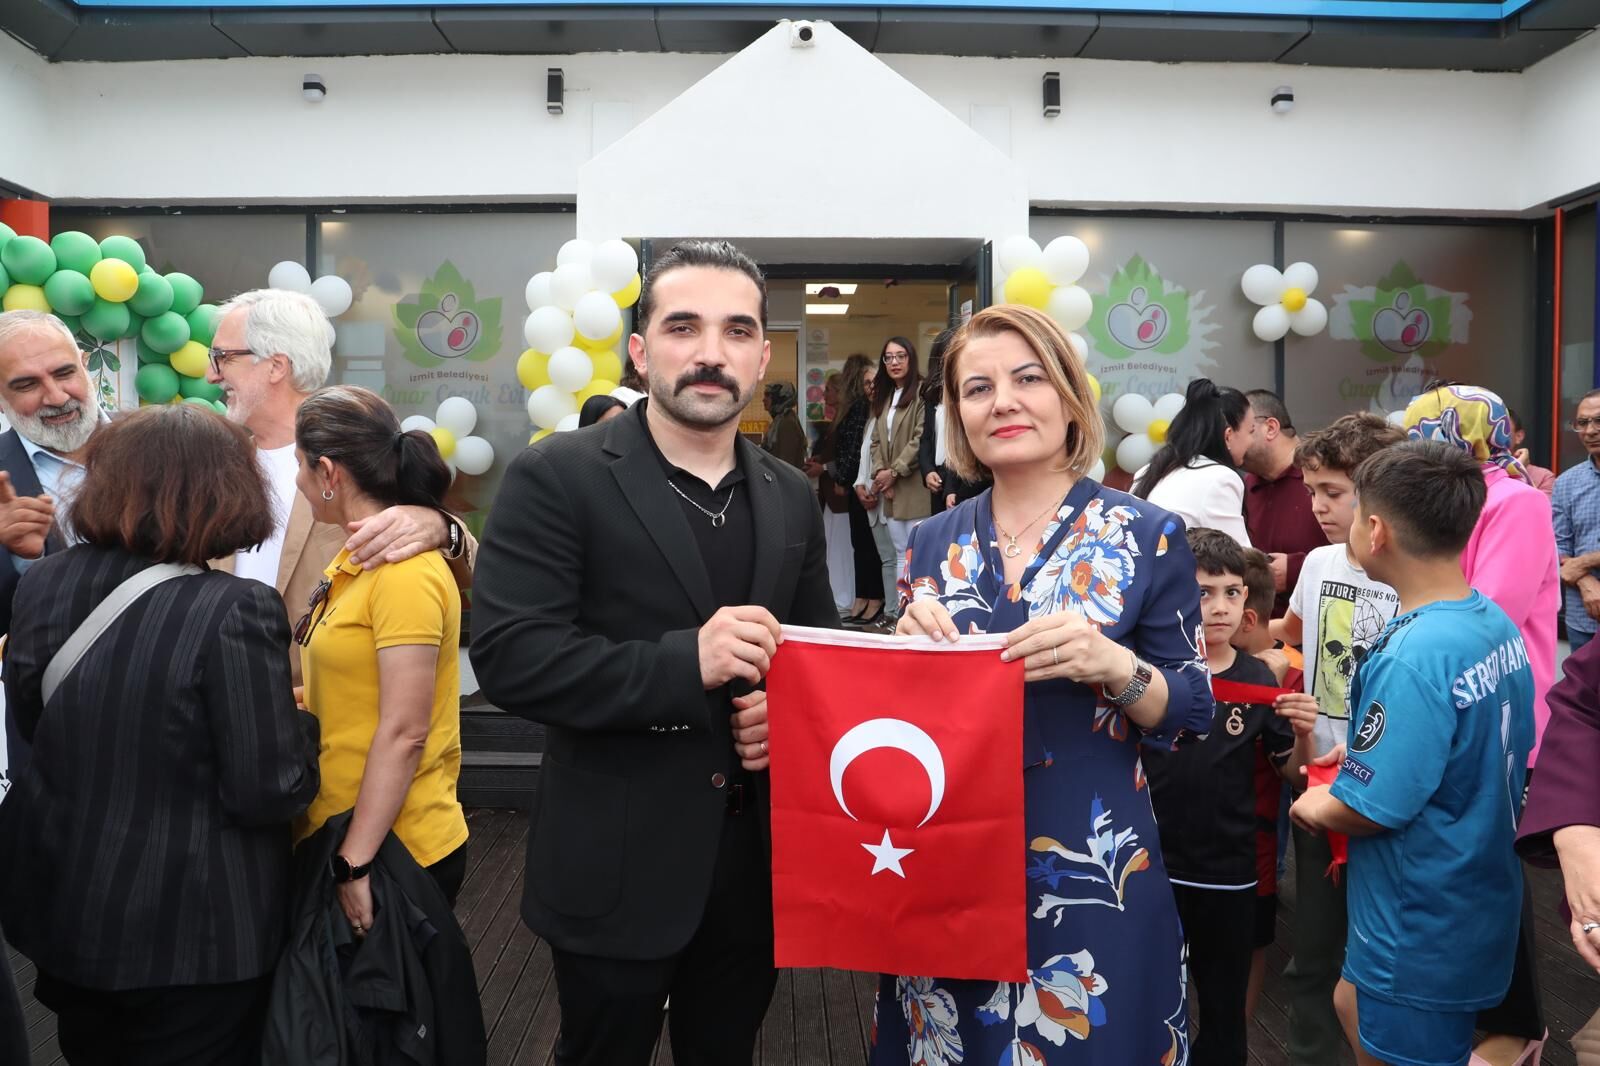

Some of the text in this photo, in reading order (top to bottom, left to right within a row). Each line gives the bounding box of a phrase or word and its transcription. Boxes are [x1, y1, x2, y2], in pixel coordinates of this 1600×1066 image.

[437, 370, 489, 382] Belediyesi
[1127, 361, 1177, 374] Belediyesi
[1321, 582, 1400, 604] FUTURE BEGINS NO
[1343, 758, 1372, 781] SPECT
